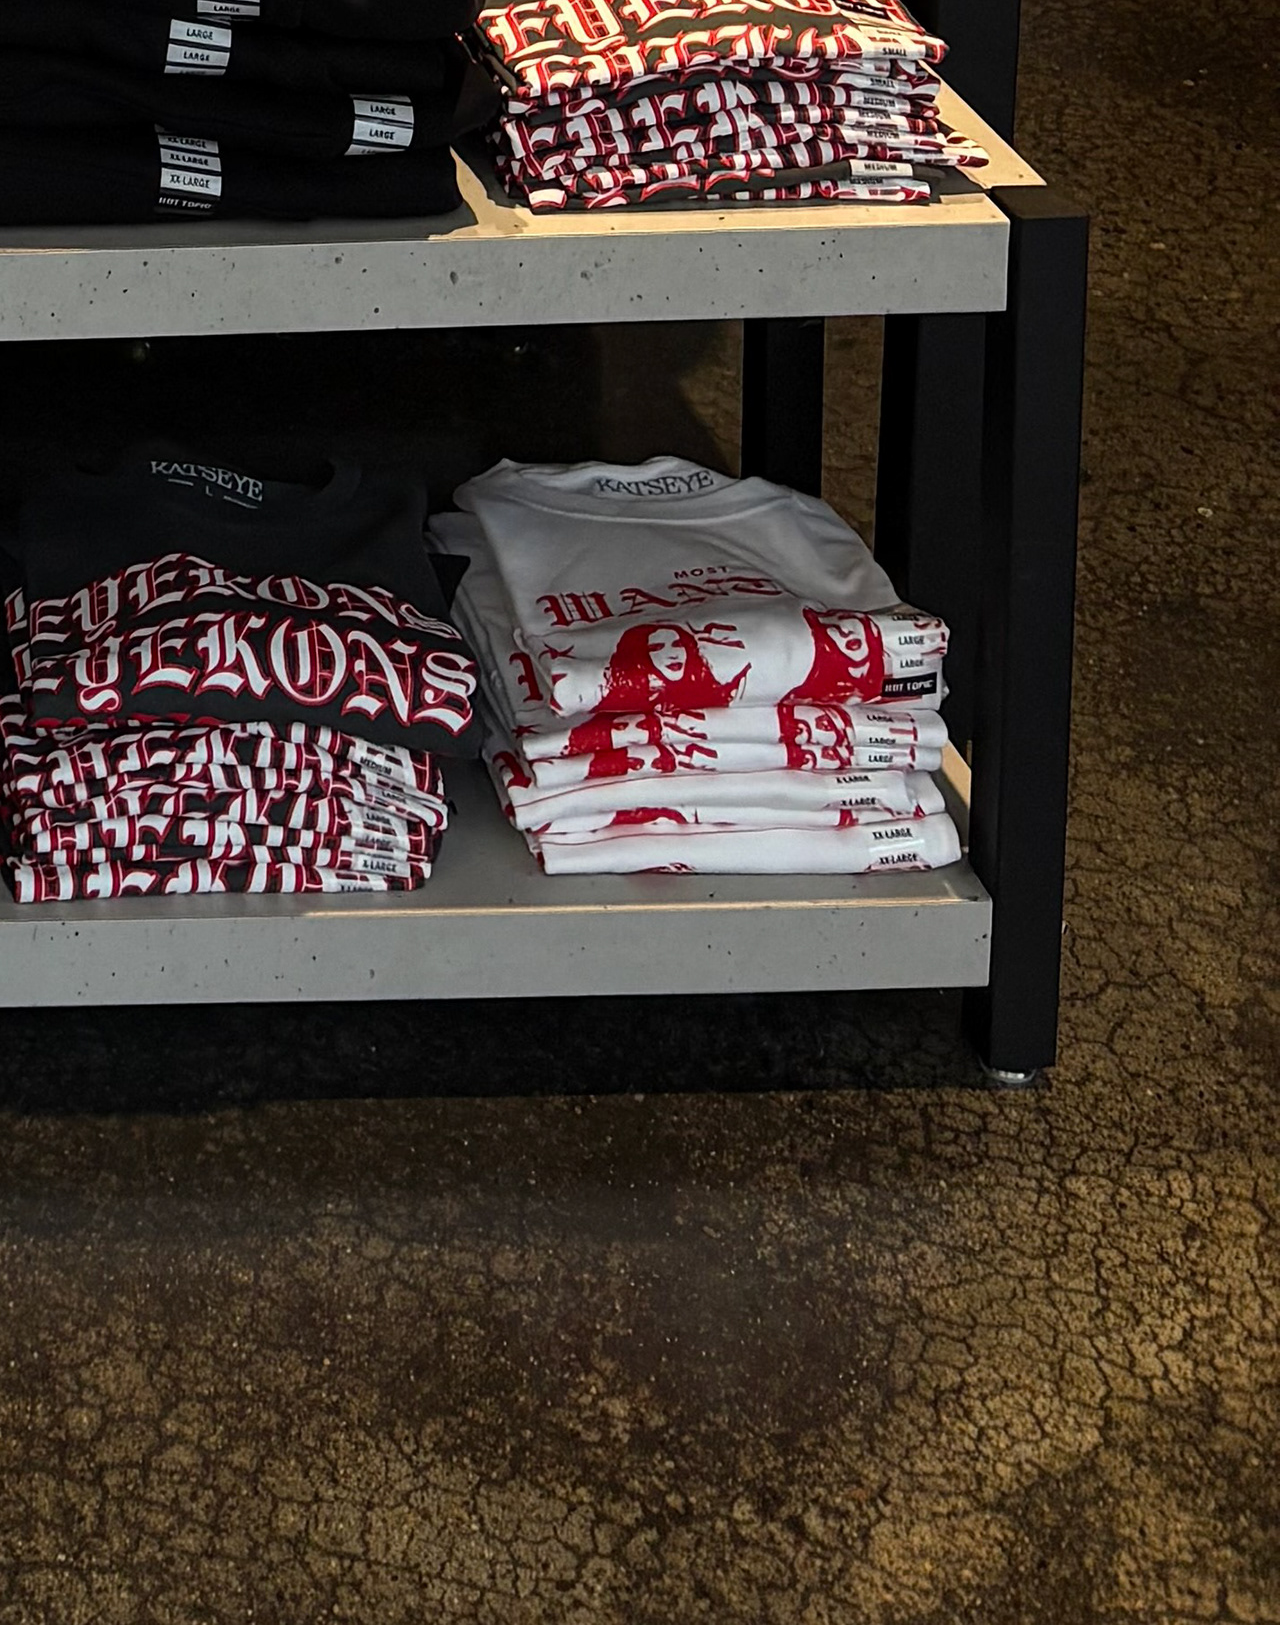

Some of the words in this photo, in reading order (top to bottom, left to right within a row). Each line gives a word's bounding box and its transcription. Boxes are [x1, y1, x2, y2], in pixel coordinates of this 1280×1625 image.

[214, 5, 240, 13] LARGE
[186, 28, 213, 41] LARGE
[183, 51, 210, 62] LARGE
[882, 48, 907, 56] SMALL
[370, 104, 396, 116] LARGE
[369, 129, 395, 140] LARGE
[864, 163, 897, 171] MEDIUM
[159, 197, 180, 206] HOT
[149, 460, 264, 501] KATSEYE
[596, 469, 715, 498] KATSEYE
[673, 564, 729, 580] MOST
[29, 551, 463, 641] EYEKONS
[899, 636, 925, 645] LARGE
[900, 659, 924, 668] LARGE
[30, 609, 478, 736] EYEKONS
[884, 681, 904, 693] HOT
[906, 679, 934, 691] TOPIC
[868, 755, 894, 763] LARGE
[360, 757, 392, 774] MEDIUM
